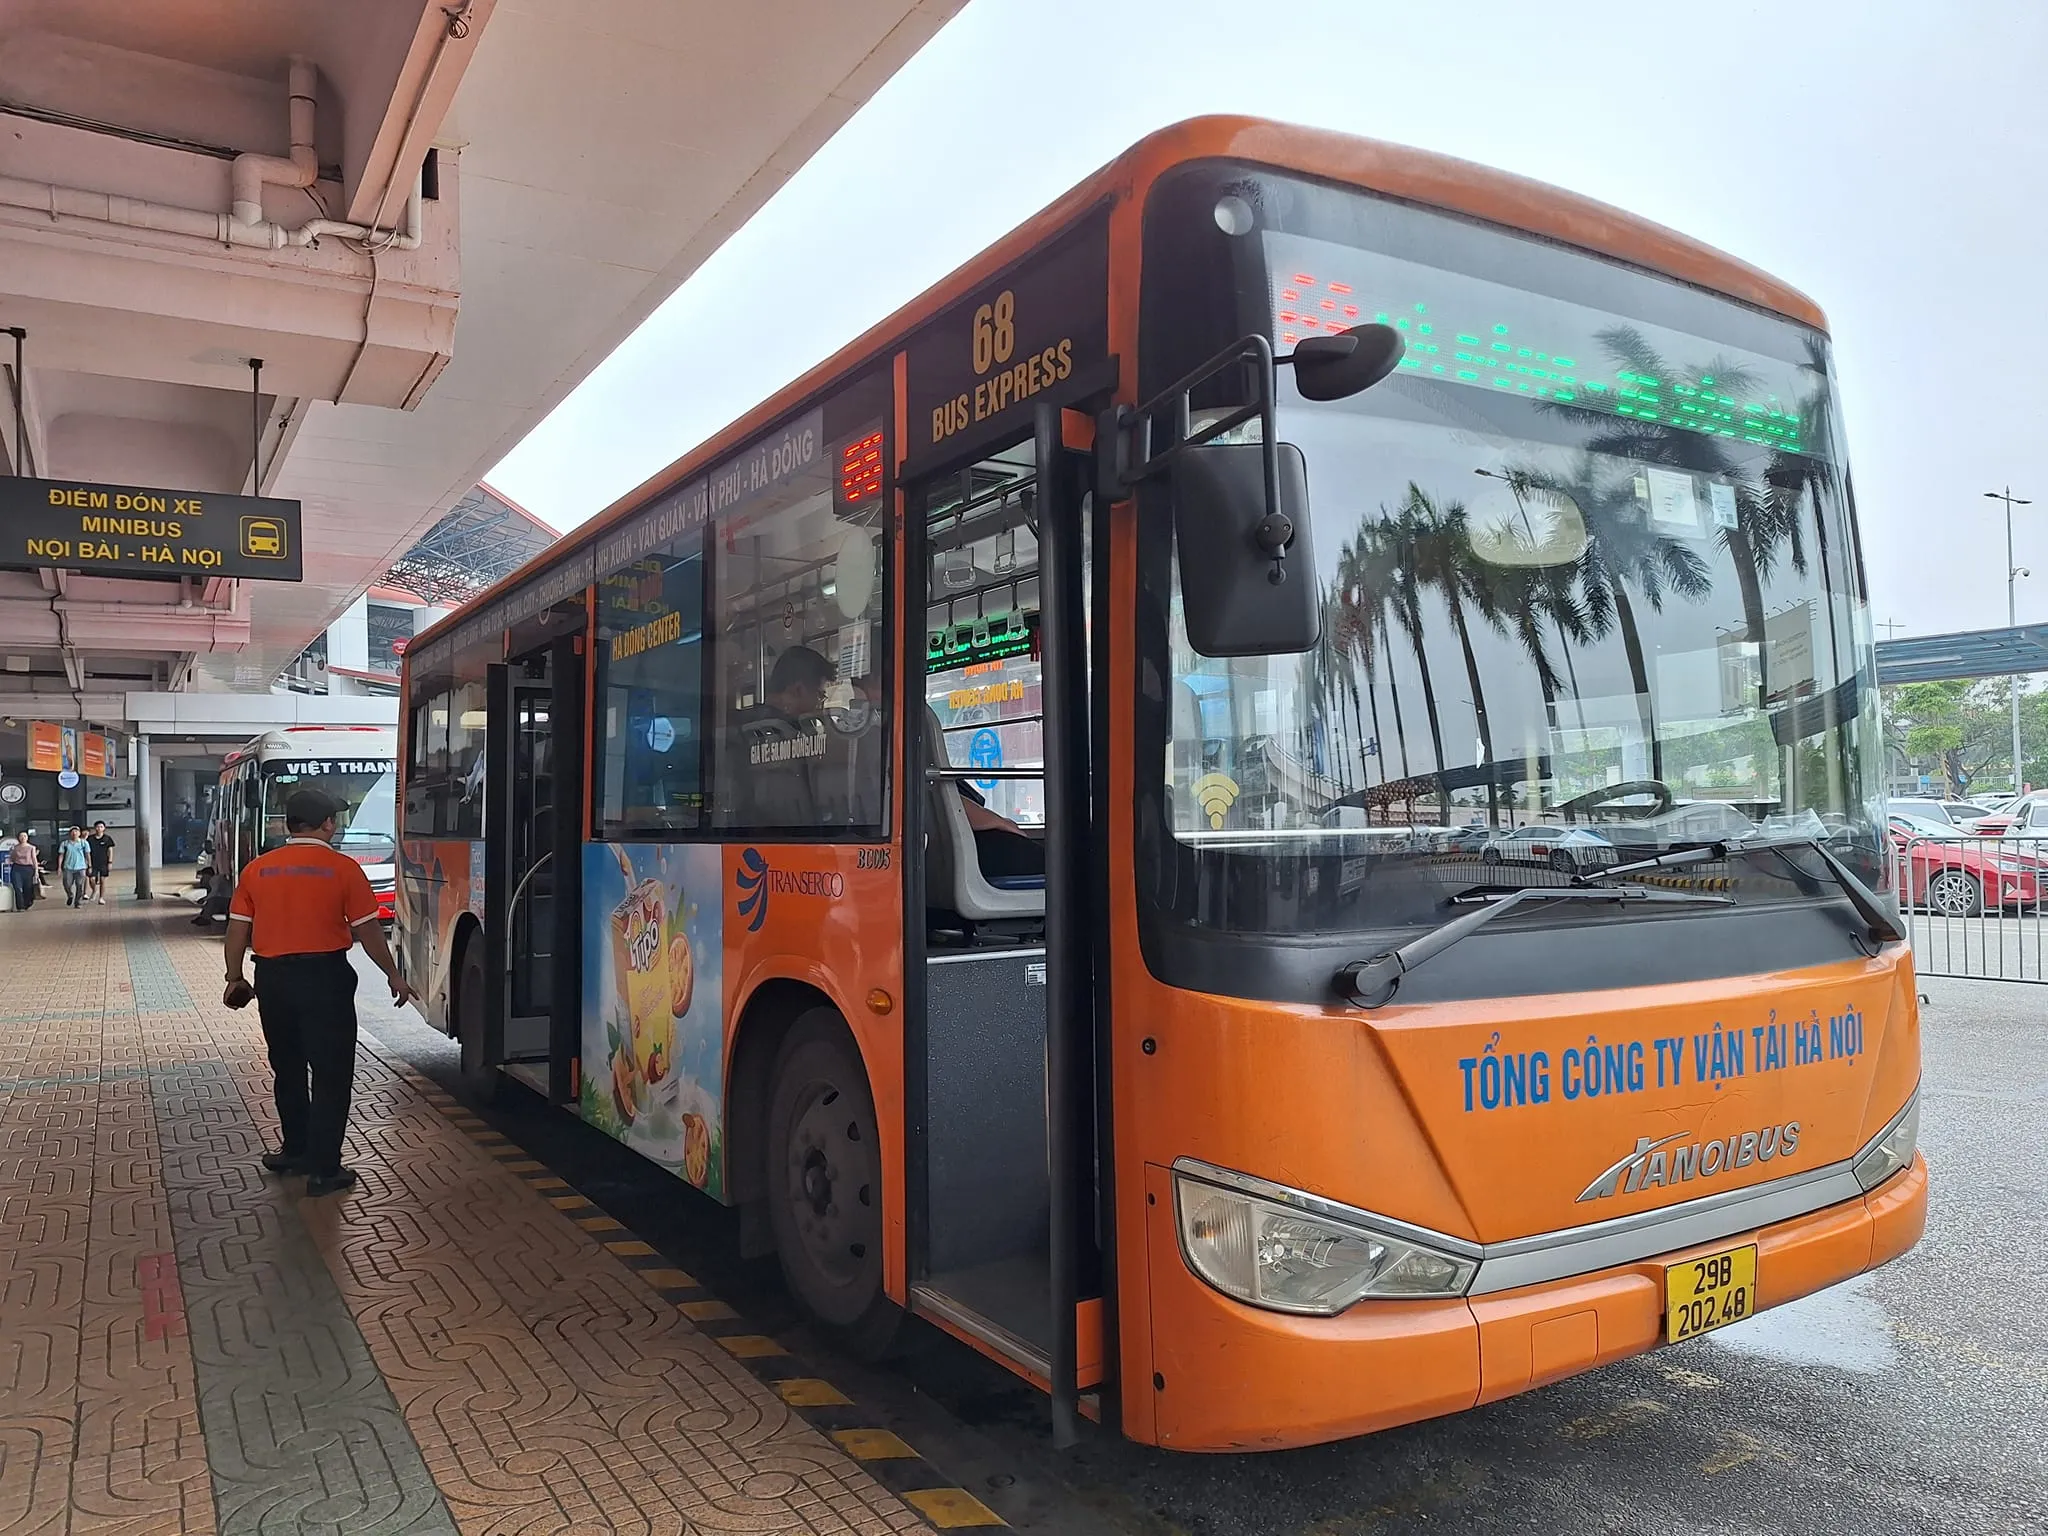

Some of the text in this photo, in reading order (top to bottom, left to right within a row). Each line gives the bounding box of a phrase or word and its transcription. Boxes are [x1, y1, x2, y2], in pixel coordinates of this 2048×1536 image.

[973, 290, 1015, 375] 68
[932, 338, 1073, 443] BUS EXPRESS
[114, 492, 166, 514] ĐÓN
[173, 499, 204, 516] XE
[610, 531, 632, 568] XUÂN
[638, 519, 657, 550] VĂN
[658, 500, 686, 542] QUÁN
[693, 481, 716, 523] VĂN
[719, 467, 741, 510] PHÚ
[751, 450, 769, 493] HÀ
[772, 429, 814, 480] ĐÔNG
[82, 516, 184, 539] MINIBUS
[26, 538, 71, 561] NỘI
[78, 538, 120, 561] BÀI
[141, 542, 176, 564] HÀ
[181, 548, 223, 570] NỘI
[647, 610, 681, 650] CENTER
[286, 760, 332, 776] VIỆT
[768, 869, 844, 898] TRANSERCO
[1458, 1003, 1864, 1113] TỔNG CÔNG TY VẬN TẢI HÀ NỘI
[1693, 1255, 1733, 1296] 29B
[1677, 1286, 1747, 1338] 202.48
